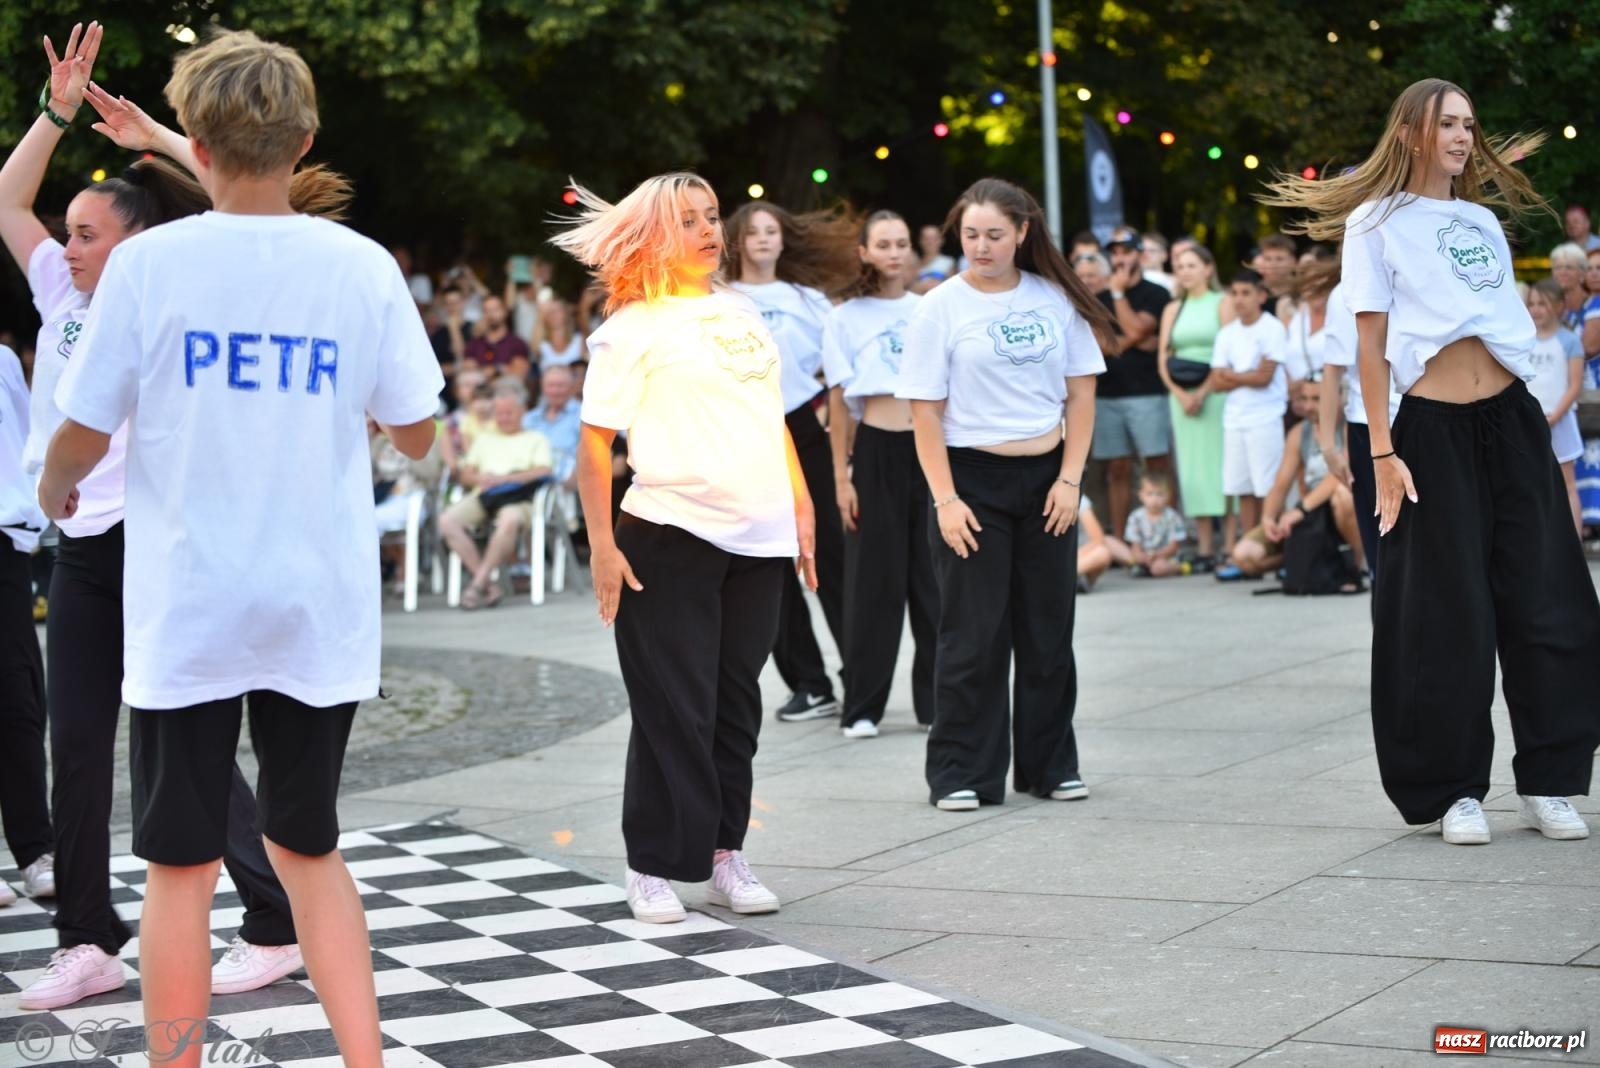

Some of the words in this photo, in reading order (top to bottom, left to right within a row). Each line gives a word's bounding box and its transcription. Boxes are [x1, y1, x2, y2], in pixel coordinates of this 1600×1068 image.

[1448, 245, 1486, 259] Dance
[1457, 255, 1489, 268] Camp
[1000, 324, 1036, 335] Dance
[1005, 332, 1036, 346] Camp
